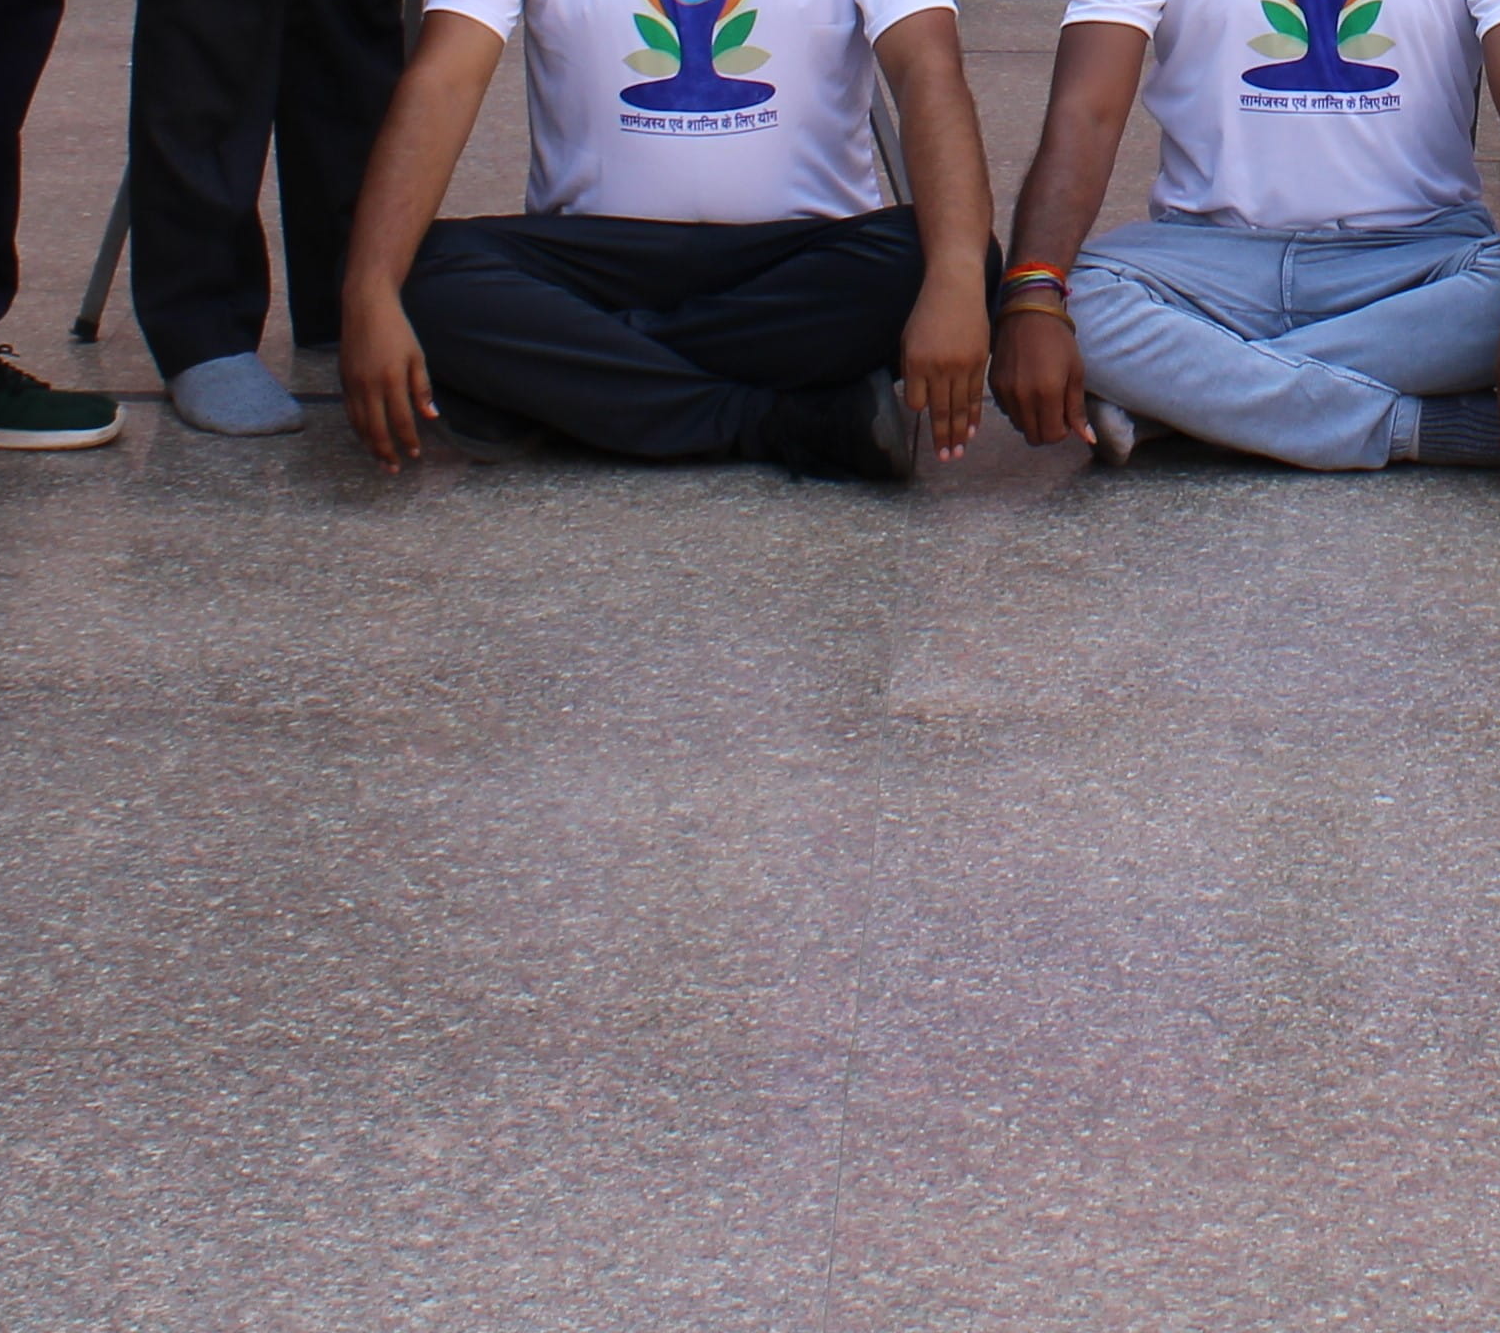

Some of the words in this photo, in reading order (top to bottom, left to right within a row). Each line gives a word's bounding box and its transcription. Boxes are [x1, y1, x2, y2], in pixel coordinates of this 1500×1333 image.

[1240, 94, 1288, 109] सामंजस्य
[1292, 94, 1306, 110] एवं
[1311, 94, 1344, 110] शान्ति
[1346, 96, 1356, 109] के
[1359, 94, 1381, 110] लिए
[1381, 92, 1400, 107] योग
[620, 114, 665, 130] सामंजस्य
[669, 115, 683, 131] एवं
[687, 114, 718, 131] शान्ति
[722, 114, 732, 129] के
[735, 112, 755, 129] लिए
[758, 109, 777, 124] योग
